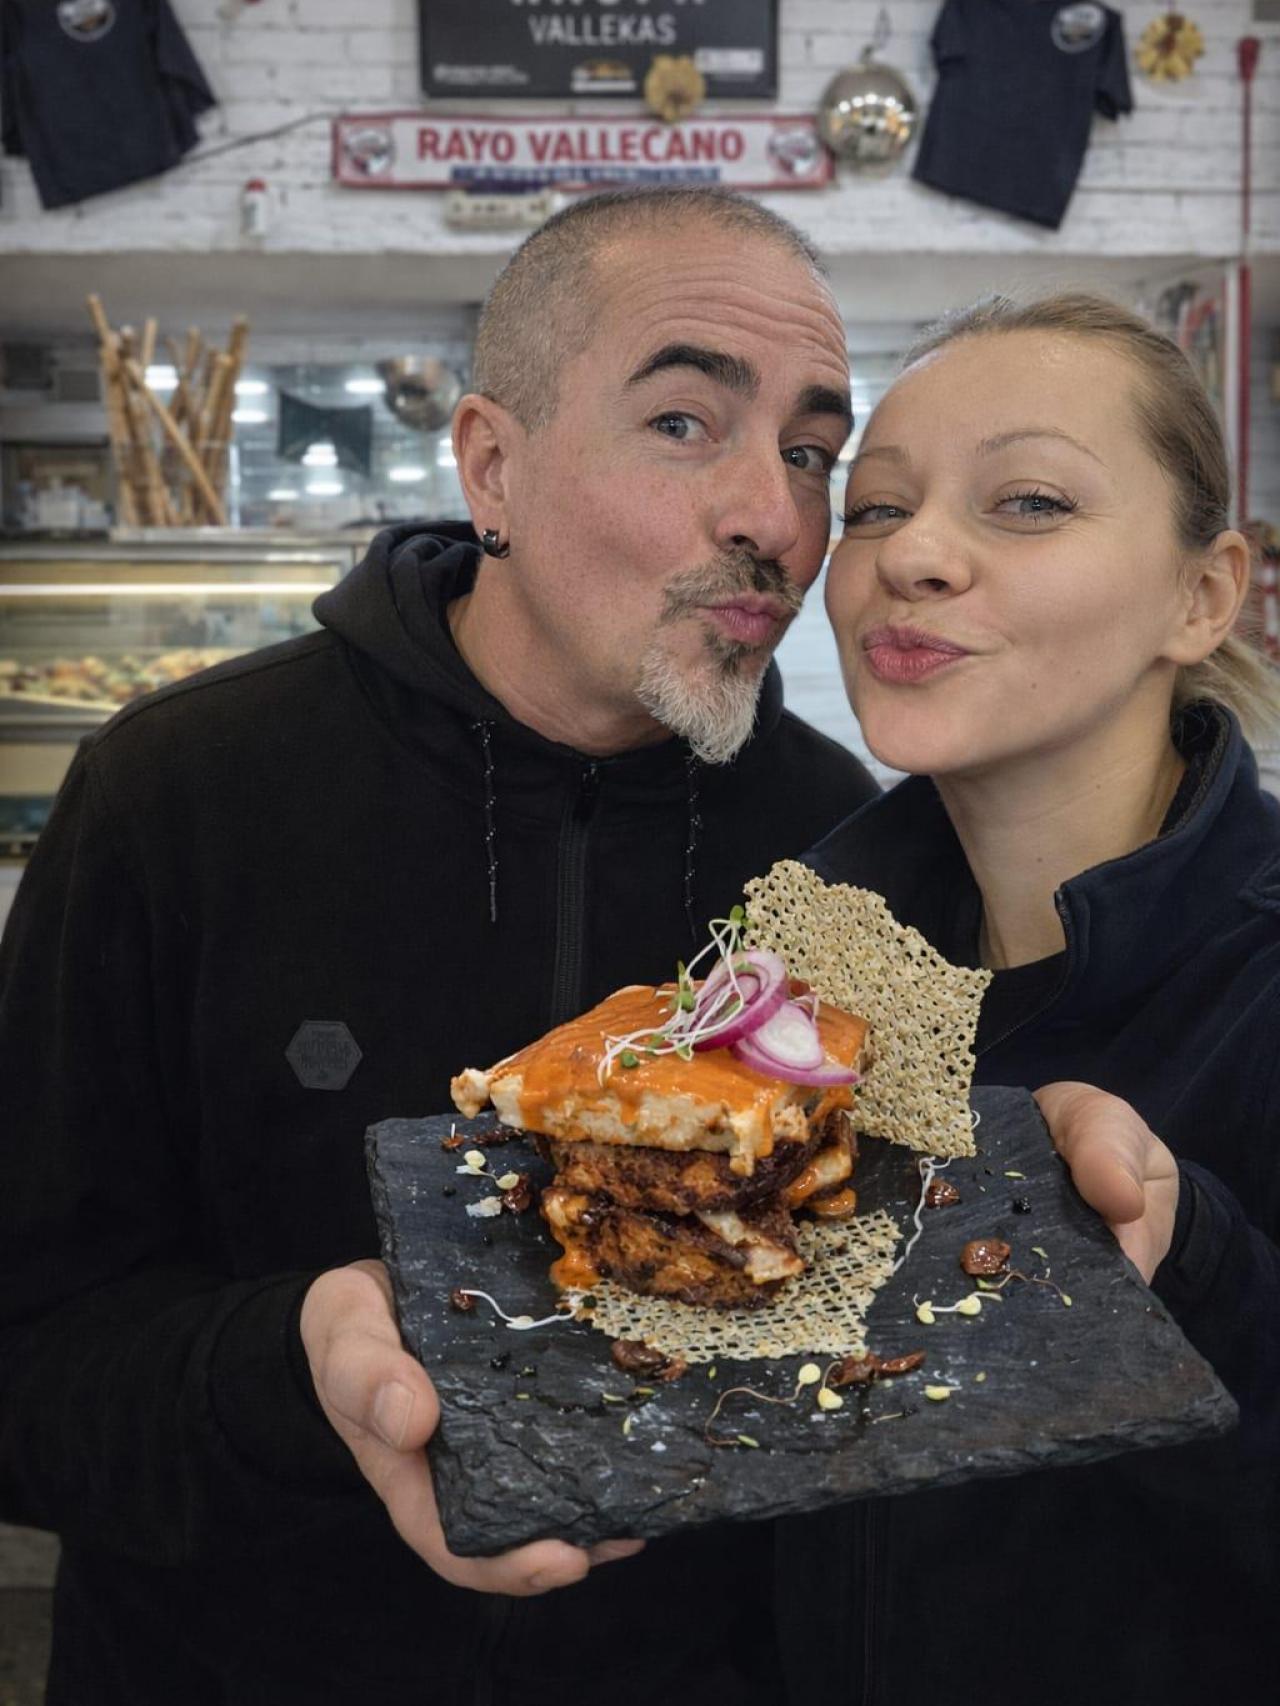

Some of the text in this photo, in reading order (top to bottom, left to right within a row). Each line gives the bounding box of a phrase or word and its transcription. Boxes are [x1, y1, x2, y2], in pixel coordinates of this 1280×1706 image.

[528, 13, 678, 45] VALLEKAS
[418, 128, 744, 163] RAYO VALLECANO
